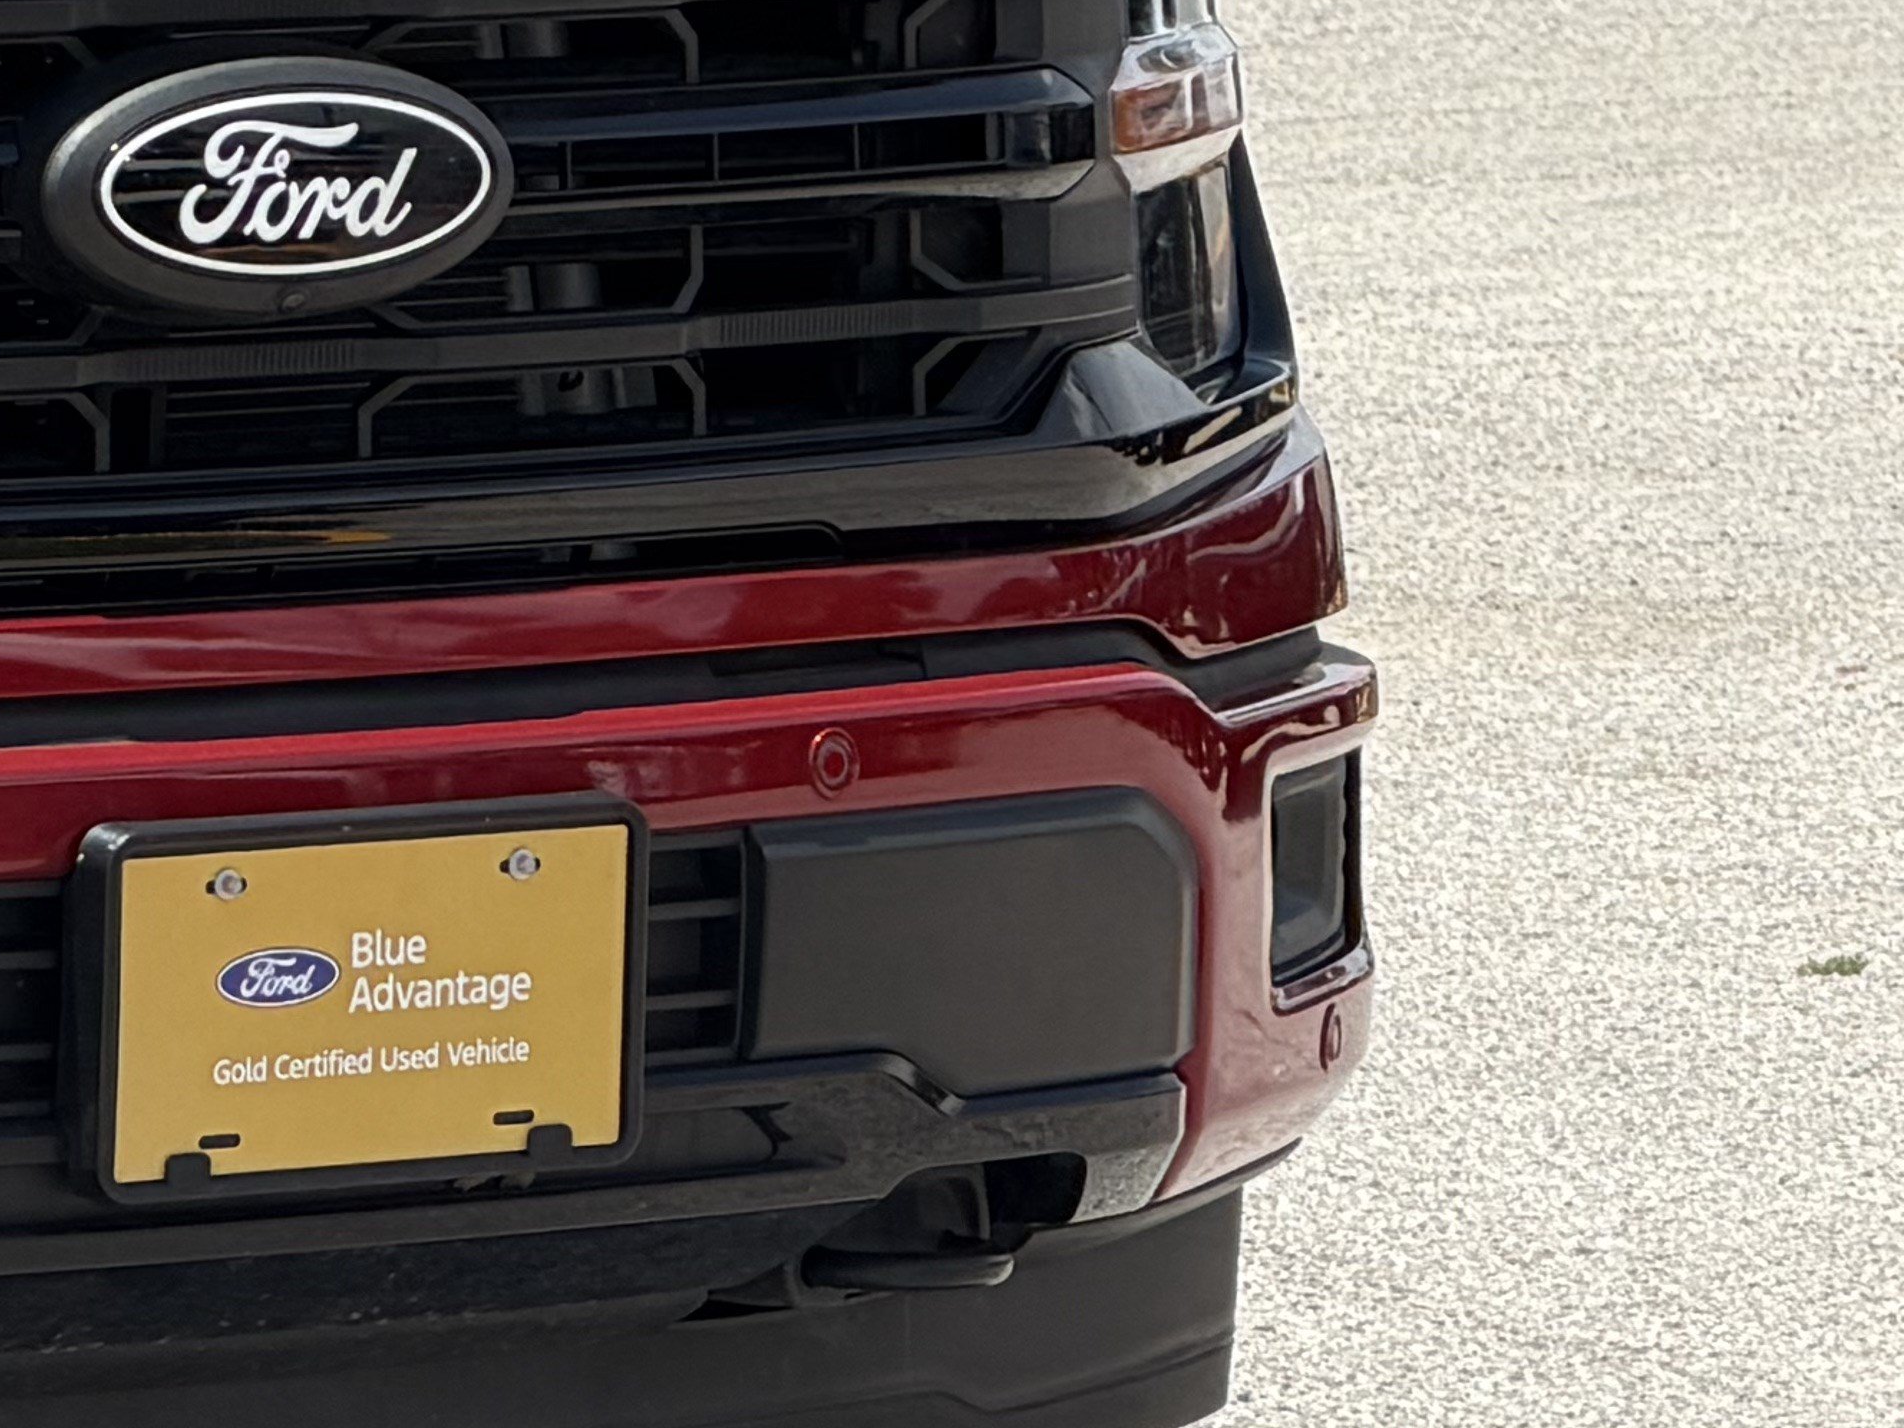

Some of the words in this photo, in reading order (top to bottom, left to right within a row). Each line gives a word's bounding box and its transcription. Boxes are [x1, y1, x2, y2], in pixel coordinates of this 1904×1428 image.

[179, 119, 419, 245] Ford
[351, 929, 427, 968] Blue
[240, 958, 313, 998] Ford
[348, 971, 532, 1013] Advantage
[212, 1054, 267, 1086] Gold
[274, 1046, 373, 1080] Certified
[380, 1044, 439, 1074] Used
[447, 1037, 530, 1067] Vehicle
